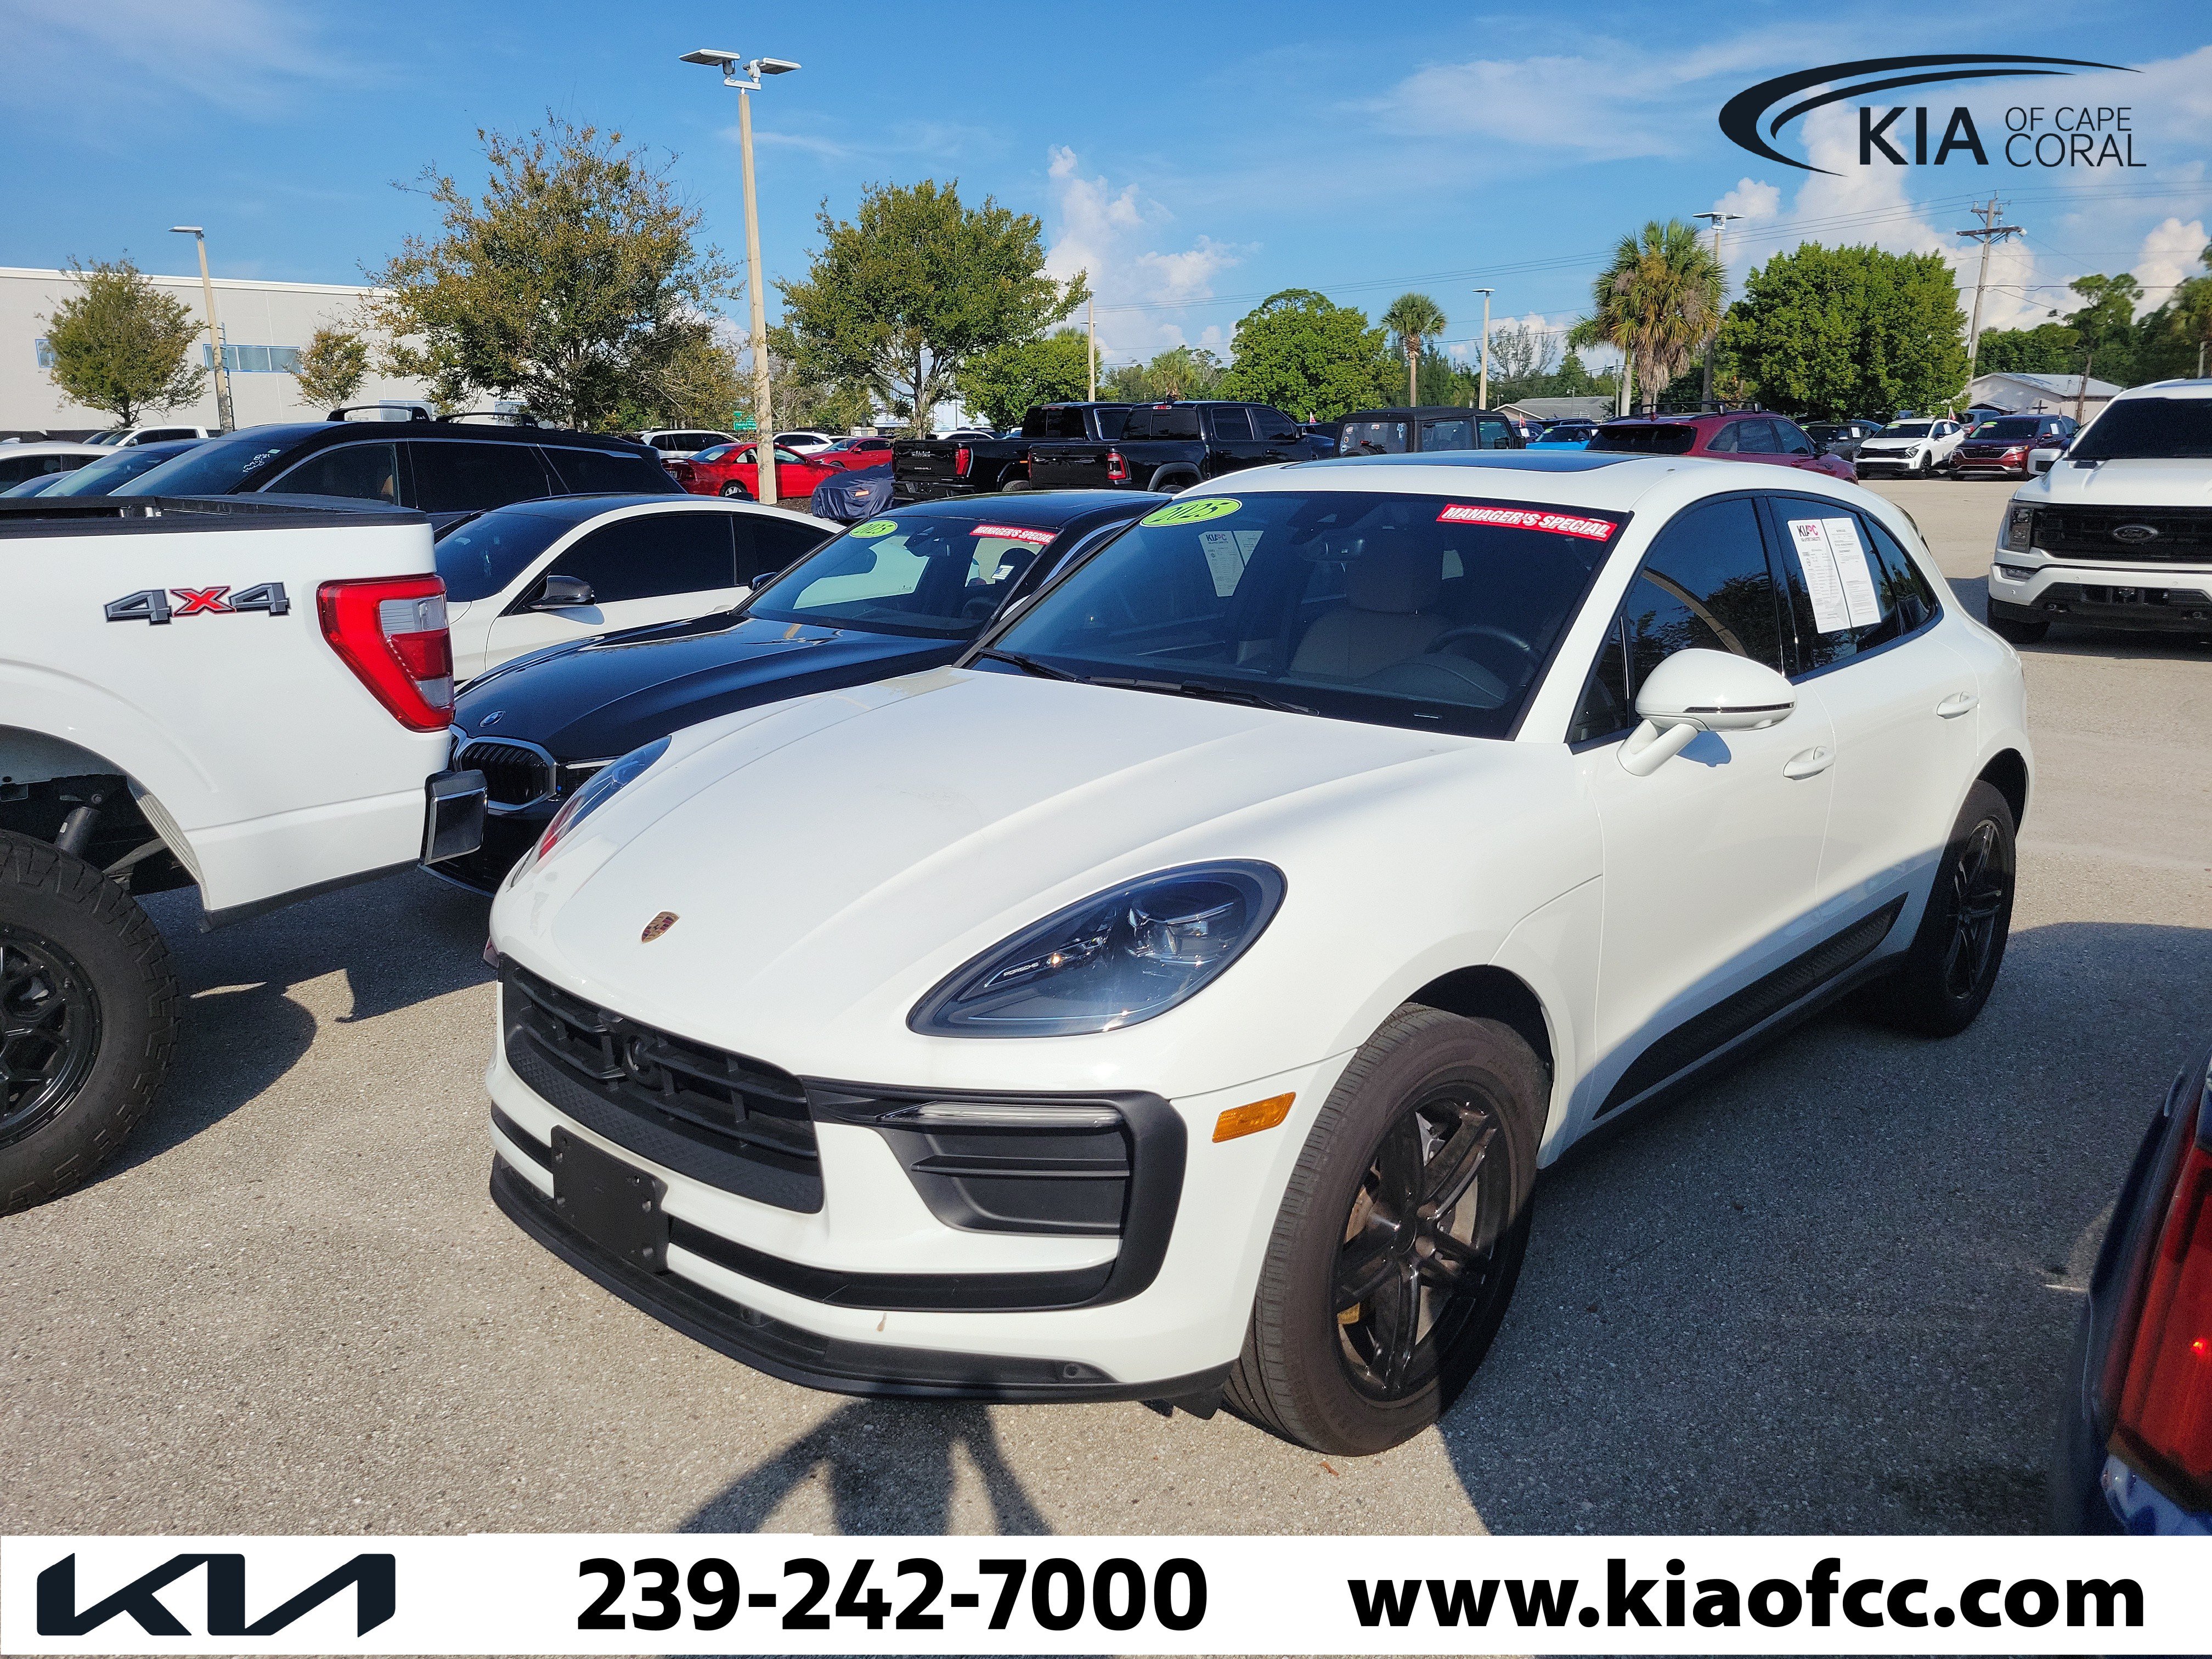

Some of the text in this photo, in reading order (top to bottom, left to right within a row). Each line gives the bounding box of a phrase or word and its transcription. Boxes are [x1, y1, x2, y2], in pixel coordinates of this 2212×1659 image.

[1149, 501, 1233, 523] 2025
[853, 523, 894, 534] 2025
[1441, 507, 1610, 538] MANAGER'S SPECIAL
[973, 526, 1055, 543] MANAGER'S SPECIAL
